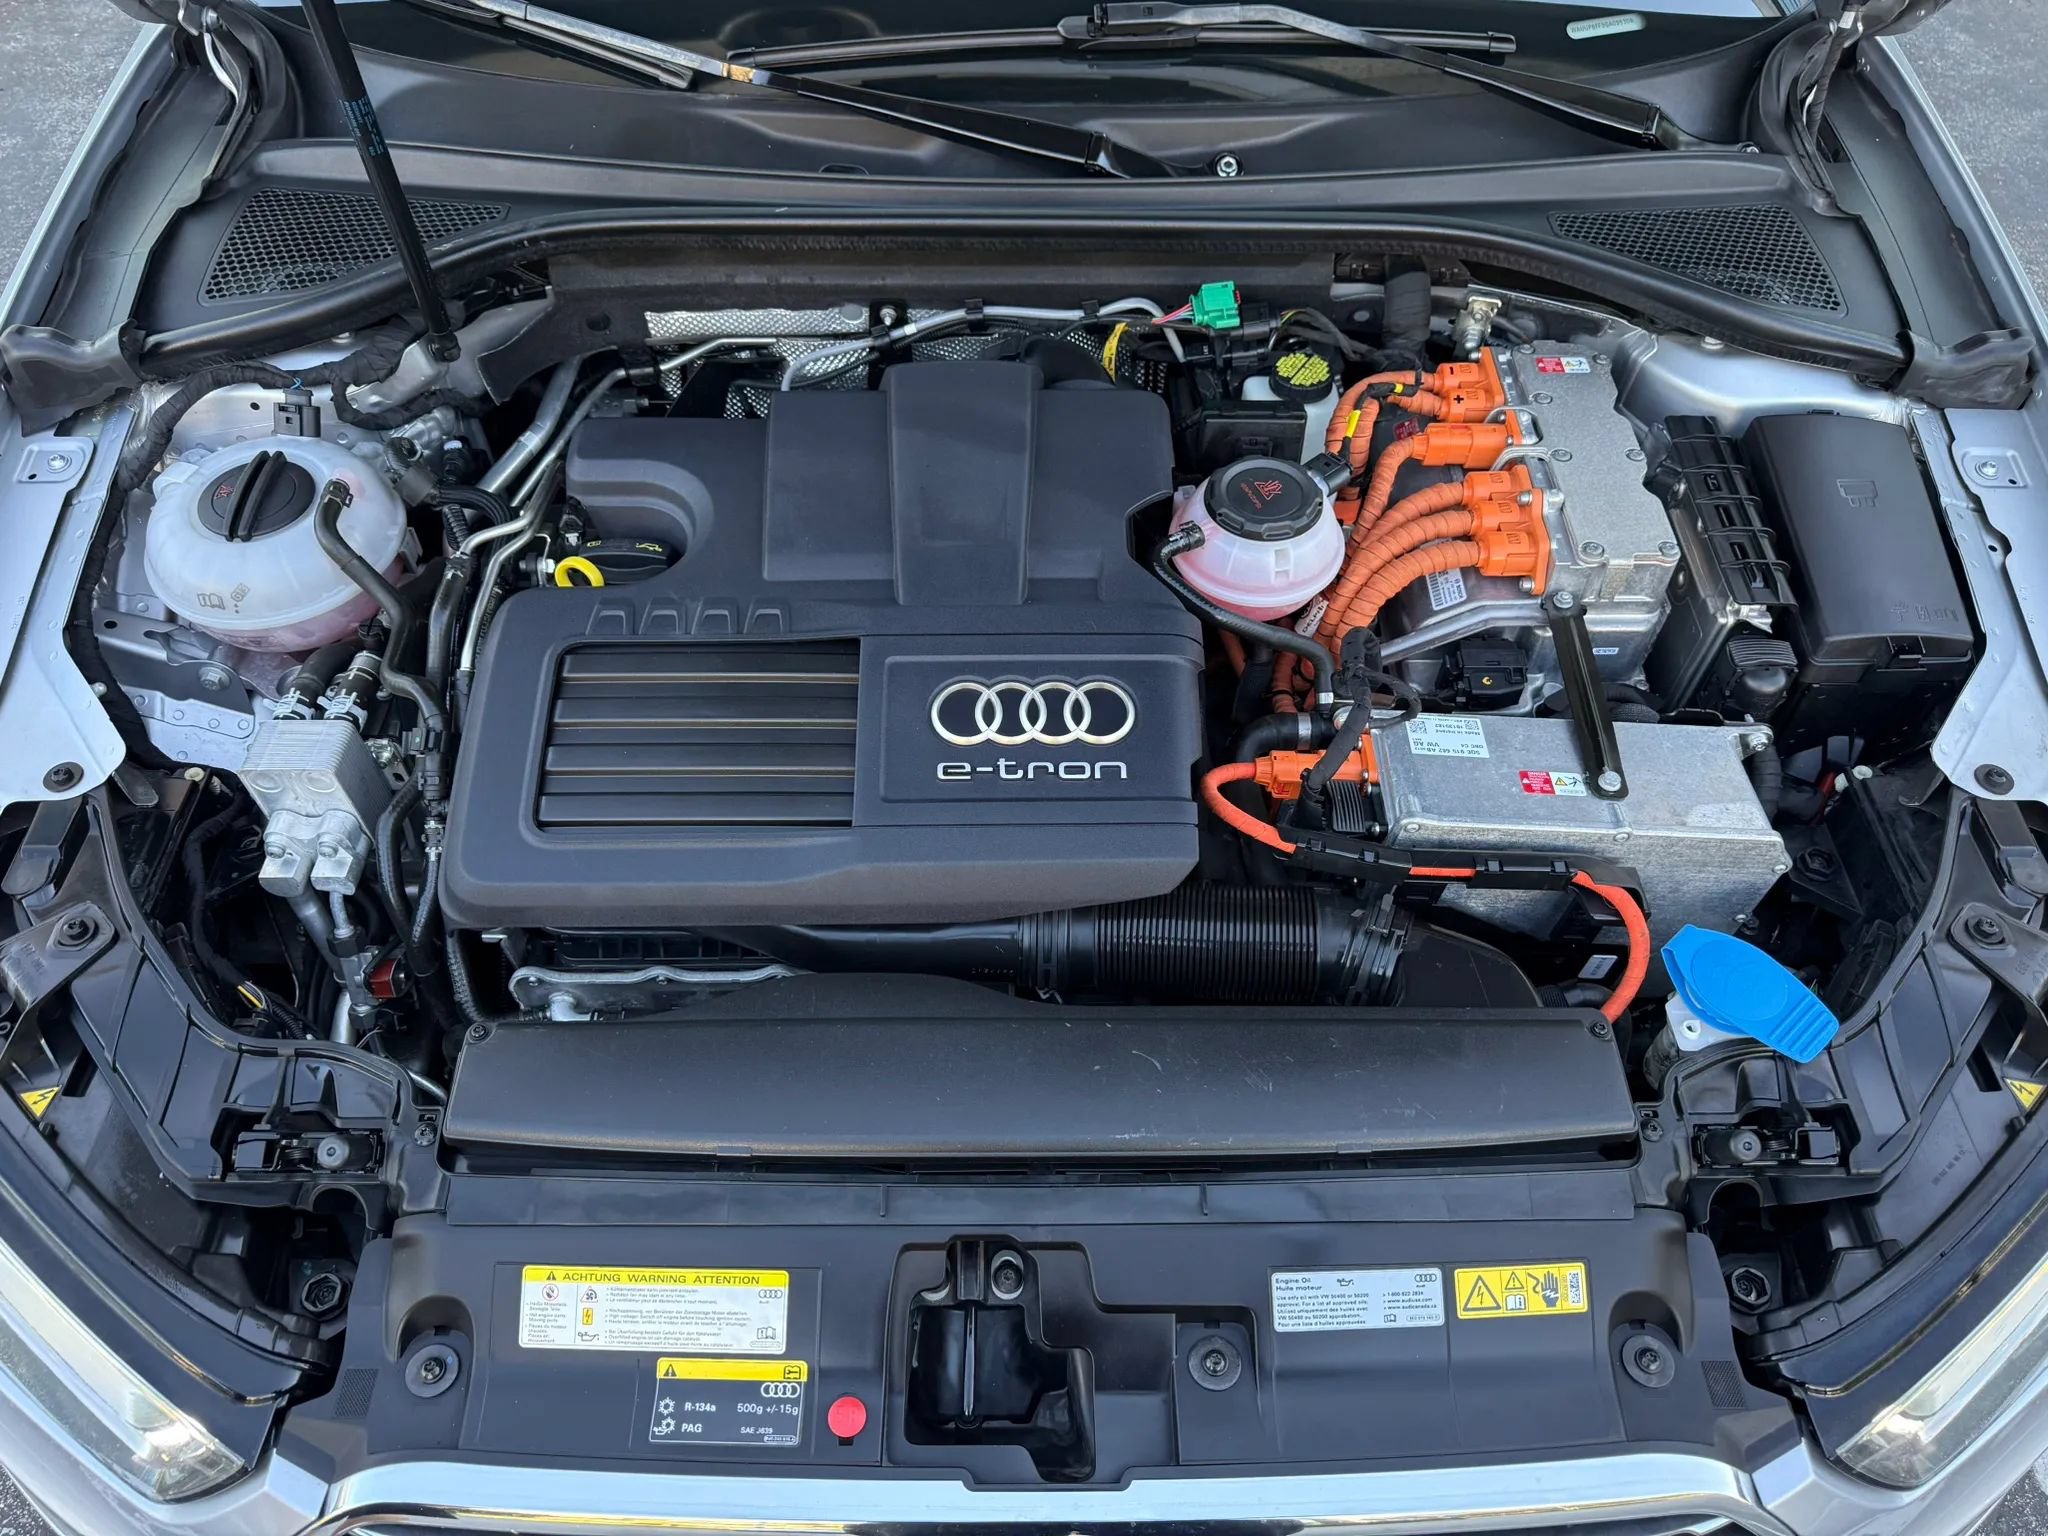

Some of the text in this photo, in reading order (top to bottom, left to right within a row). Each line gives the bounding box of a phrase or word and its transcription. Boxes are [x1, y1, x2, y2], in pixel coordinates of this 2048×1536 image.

[937, 758, 1128, 780] e-tron
[562, 1272, 760, 1285] ACHTUNG WARNING ATTENTION
[684, 1402, 716, 1412] R-134a
[737, 1404, 763, 1414] 500g
[682, 1424, 702, 1432] PAG
